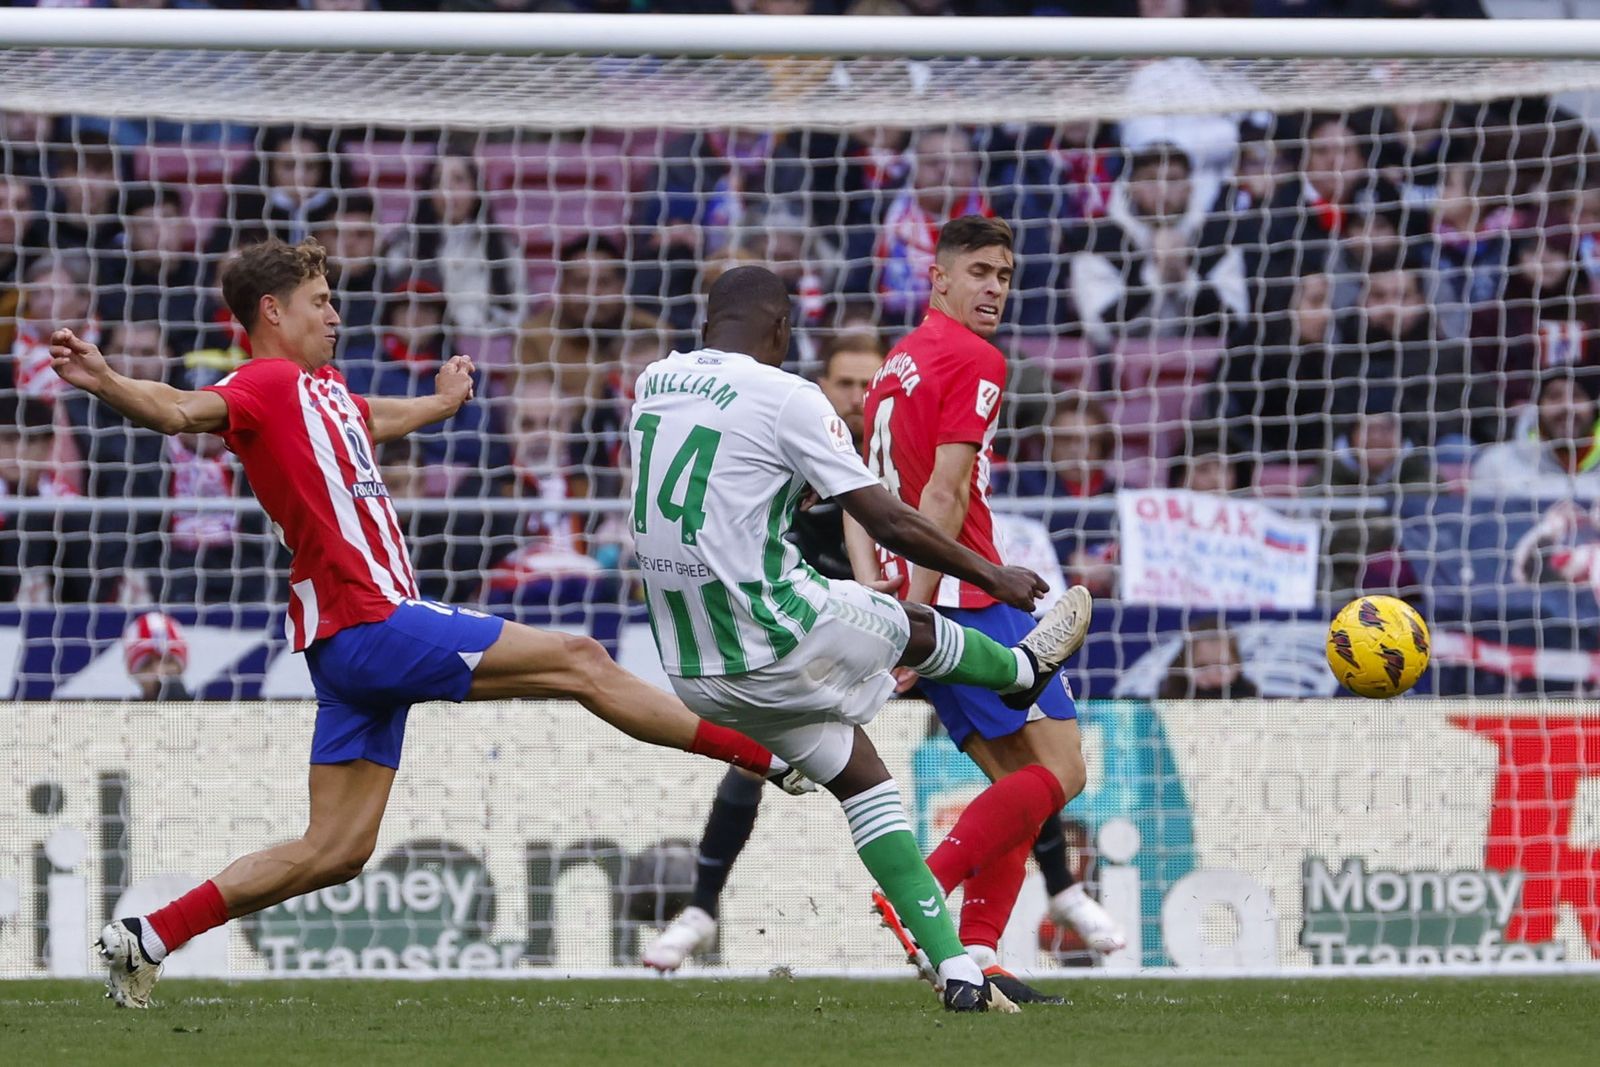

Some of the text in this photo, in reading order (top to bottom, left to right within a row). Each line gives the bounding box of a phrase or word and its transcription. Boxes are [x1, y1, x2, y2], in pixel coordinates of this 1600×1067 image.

[644, 373, 738, 411] WILLIAM
[633, 411, 722, 546] 14
[1306, 857, 1525, 926] Money
[258, 930, 528, 972] Transfer
[1304, 929, 1568, 967] Transfer
